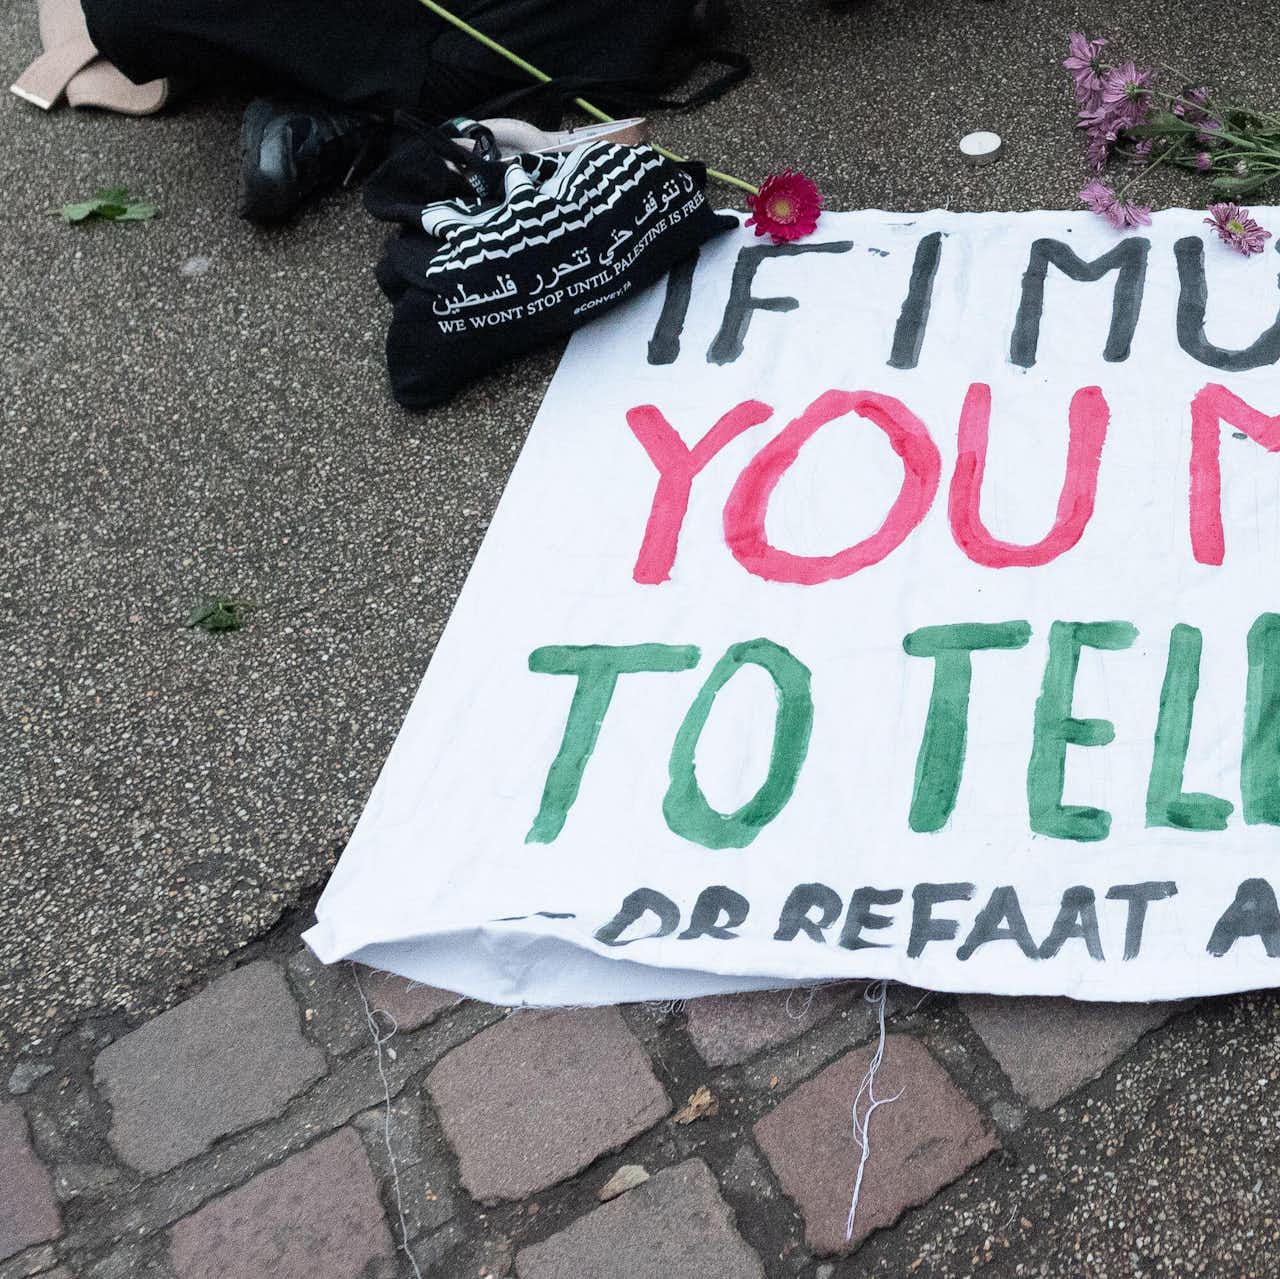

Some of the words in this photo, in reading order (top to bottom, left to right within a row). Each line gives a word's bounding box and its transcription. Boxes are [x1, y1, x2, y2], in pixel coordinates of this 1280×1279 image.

[634, 179, 681, 225] نتوقف
[432, 273, 518, 316] فلسطين
[438, 319, 467, 334] WE
[469, 306, 523, 329] WONT
[527, 290, 564, 316] STOP
[567, 270, 613, 297] UNTIL
[613, 219, 668, 276] PALESTINE
[668, 210, 682, 226] IS
[680, 190, 705, 218] FREE
[529, 246, 592, 296] تتحرر
[647, 240, 854, 366] IF
[887, 231, 945, 369] I
[625, 382, 1111, 586] YOU
[525, 637, 814, 850] TO
[593, 885, 750, 946] DR
[773, 880, 1179, 962] REFAAT
